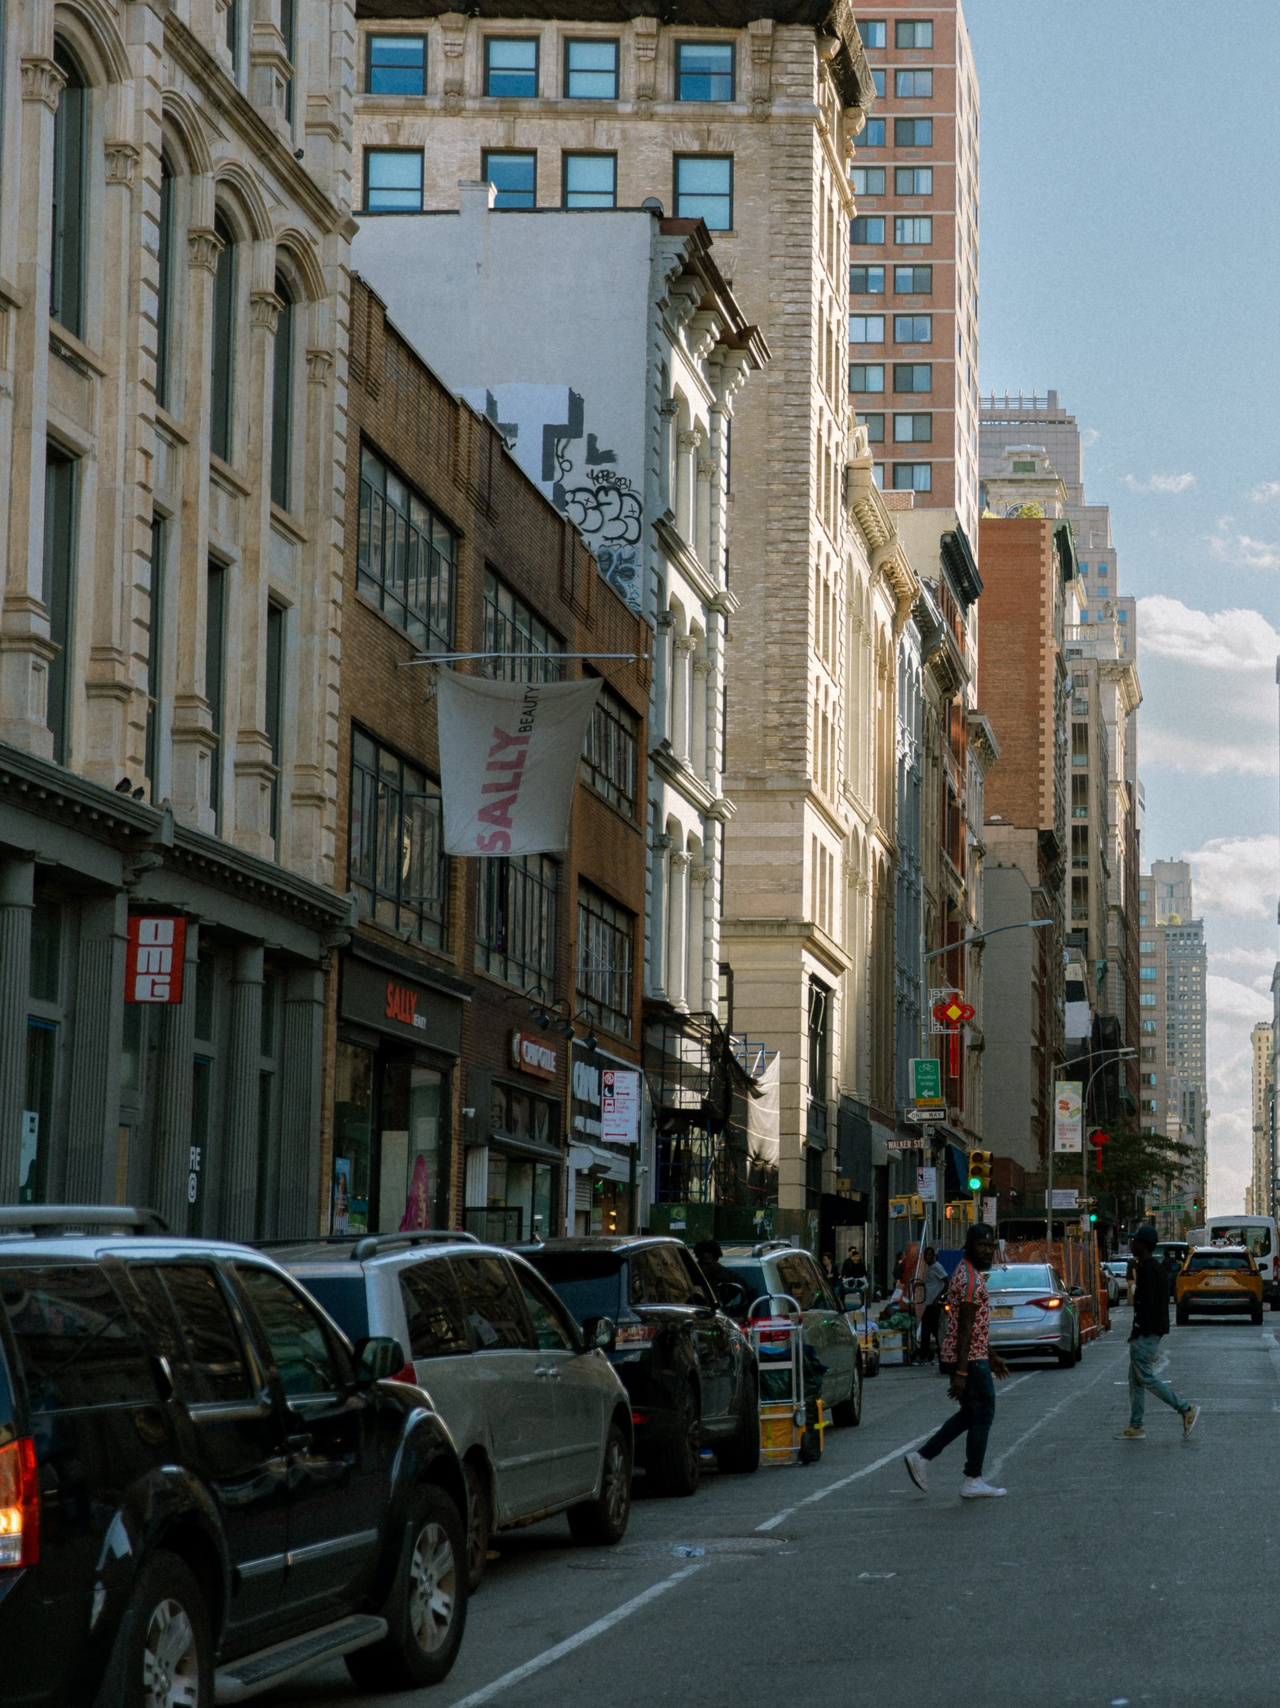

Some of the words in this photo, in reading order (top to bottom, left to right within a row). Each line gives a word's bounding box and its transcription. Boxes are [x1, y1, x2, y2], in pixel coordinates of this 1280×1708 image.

[518, 685, 540, 733] BEAUTY
[476, 726, 531, 853] SALLY
[134, 918, 175, 1002] OMG
[386, 983, 418, 1024] SALLY
[887, 1140, 912, 1149] WALKER
[913, 1140, 922, 1148] ST
